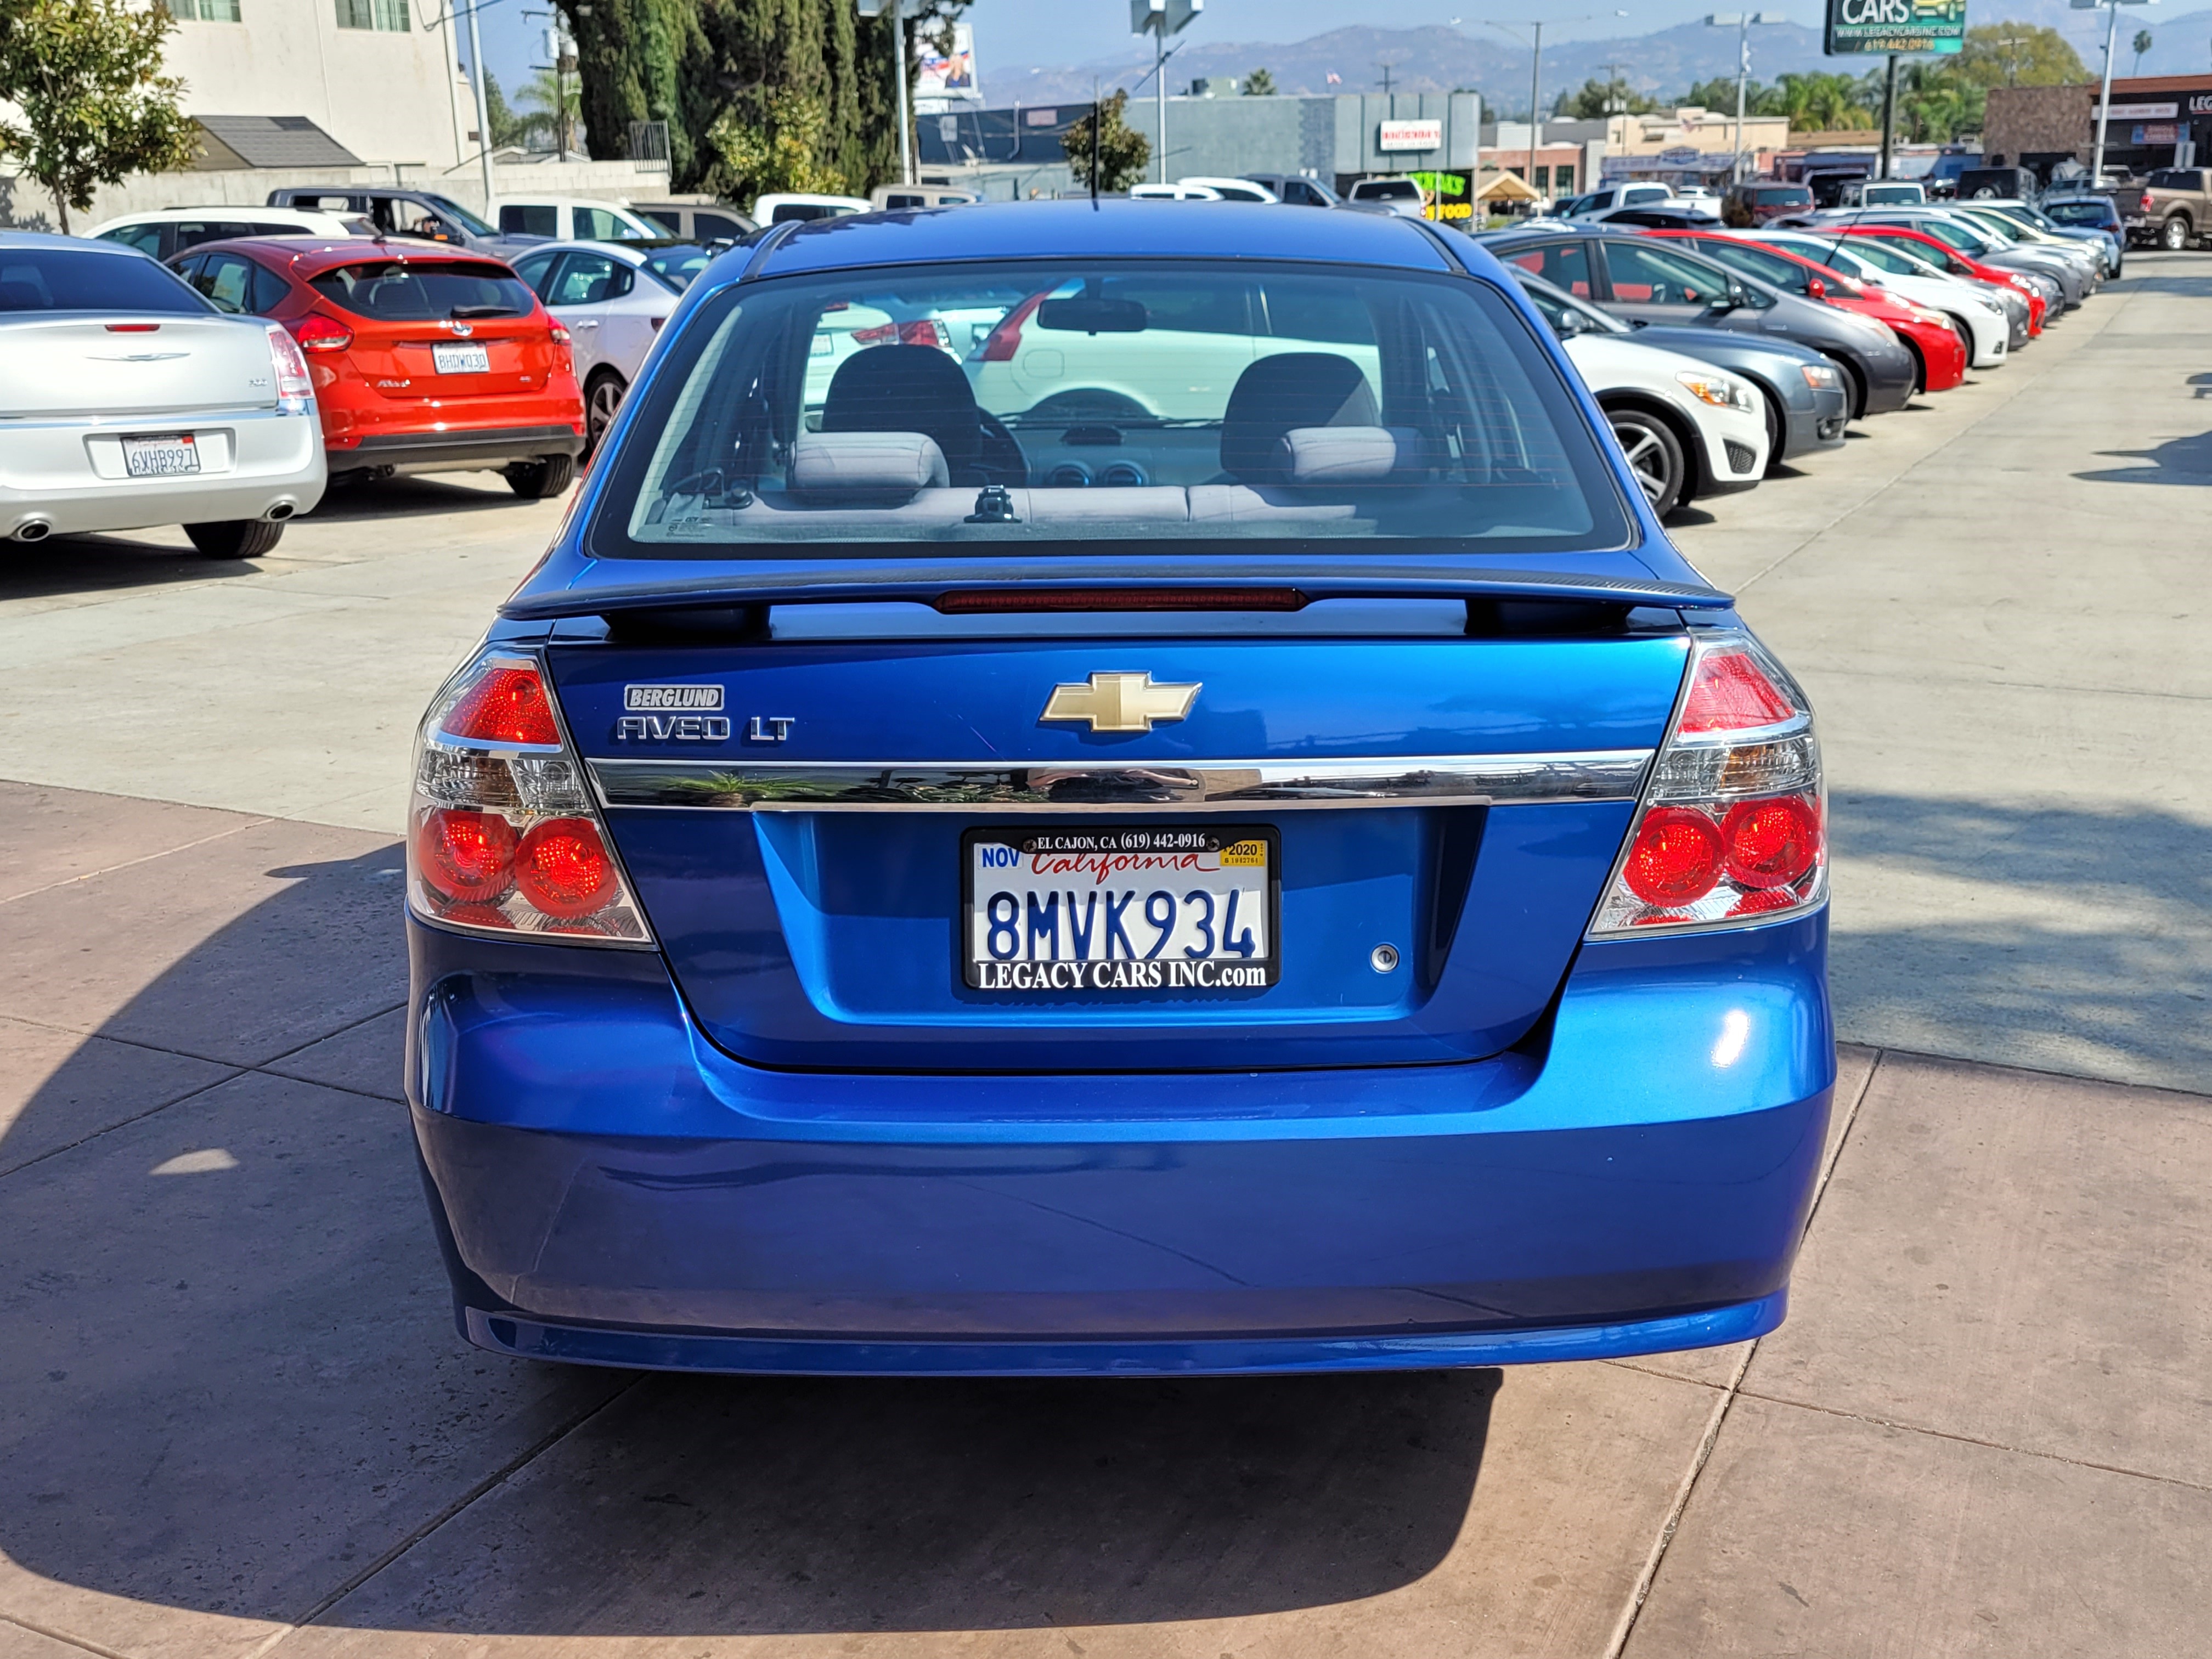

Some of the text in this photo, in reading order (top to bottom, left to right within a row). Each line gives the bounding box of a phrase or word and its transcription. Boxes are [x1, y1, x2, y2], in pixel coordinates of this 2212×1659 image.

[1842, 0, 1909, 24] CARS
[1438, 203, 1472, 220] FOOD
[630, 689, 719, 707] BERGLUND
[617, 716, 795, 741] AVEO LT
[1037, 832, 1206, 851] EL CAJON, CA (619) 442-0916
[1228, 844, 1257, 855] 2020
[983, 848, 1020, 867] NOV
[1031, 853, 1221, 885] California
[988, 889, 1256, 960] 8MVK934
[979, 961, 1267, 989] LEGACY CARS INC.com
